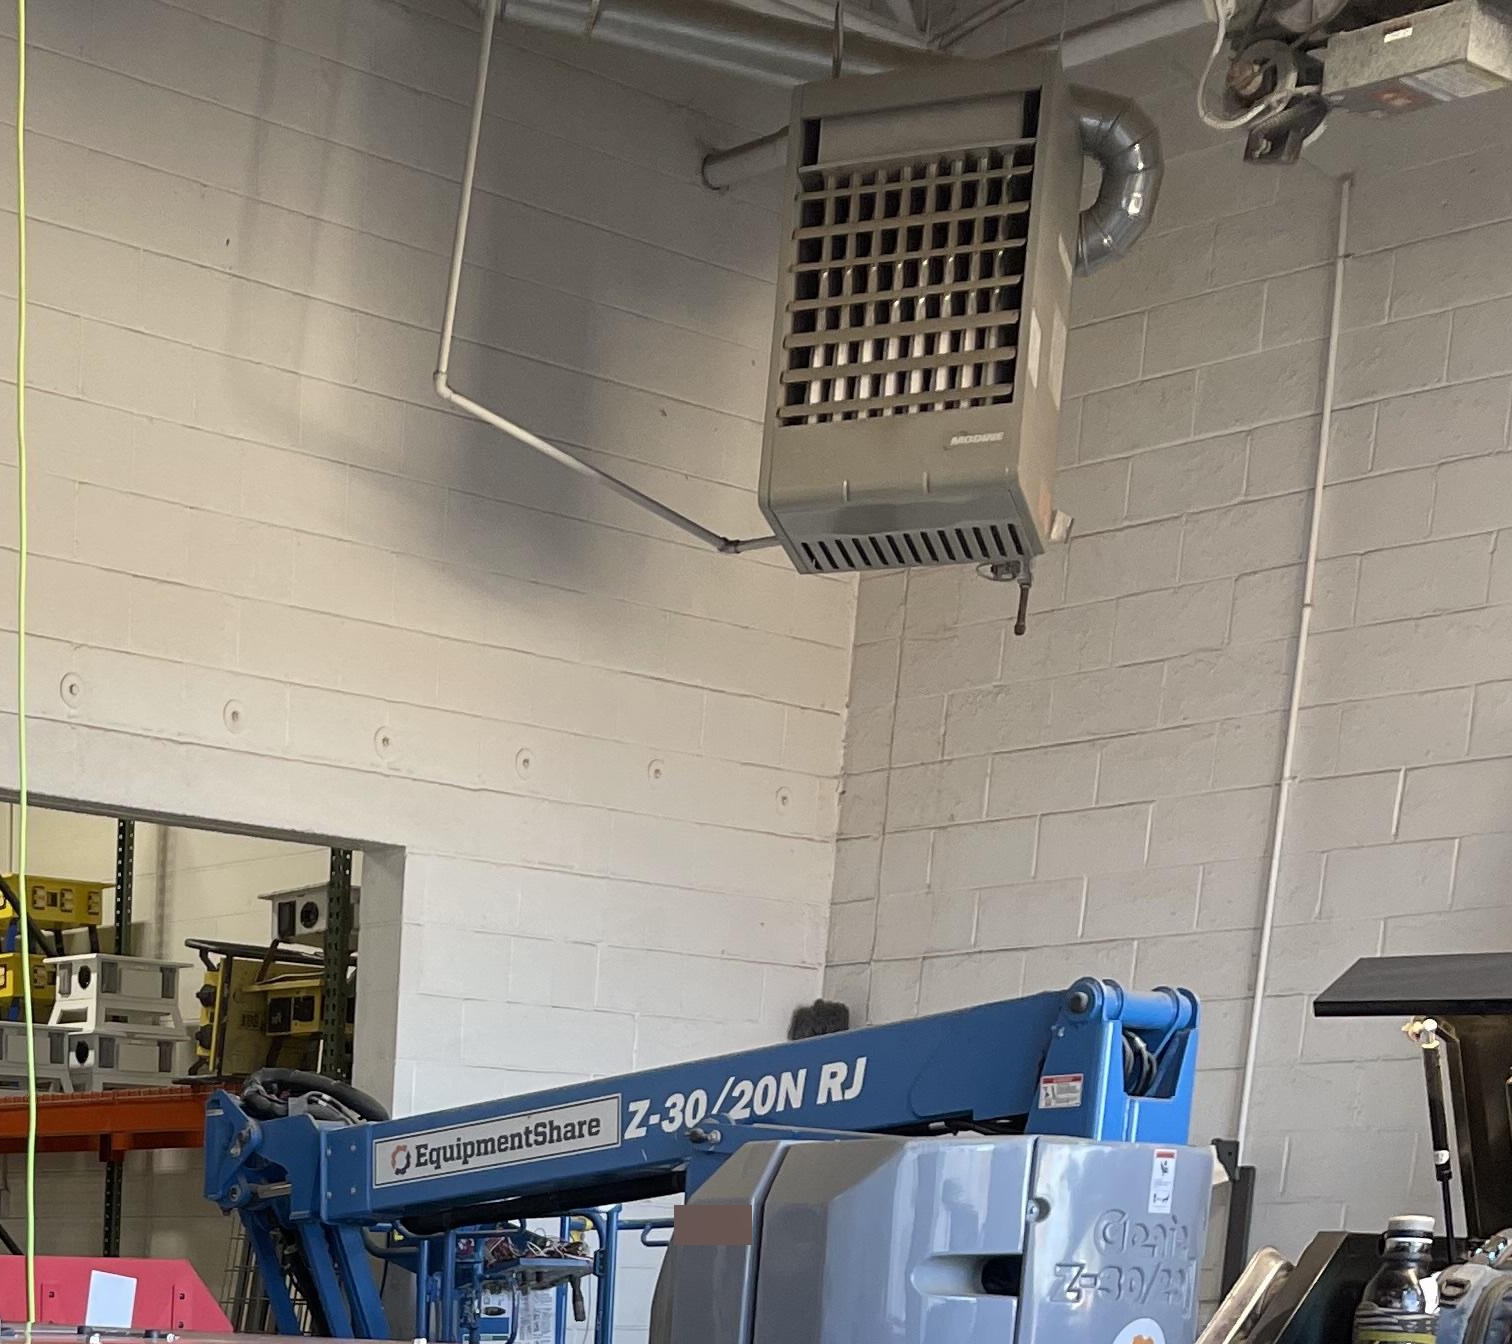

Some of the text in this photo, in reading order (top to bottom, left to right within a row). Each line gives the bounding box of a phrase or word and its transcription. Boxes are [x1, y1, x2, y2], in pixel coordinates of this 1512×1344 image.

[624, 1056, 868, 1141] Z-30/20N RJ
[414, 1114, 602, 1169] EquipmentShare
